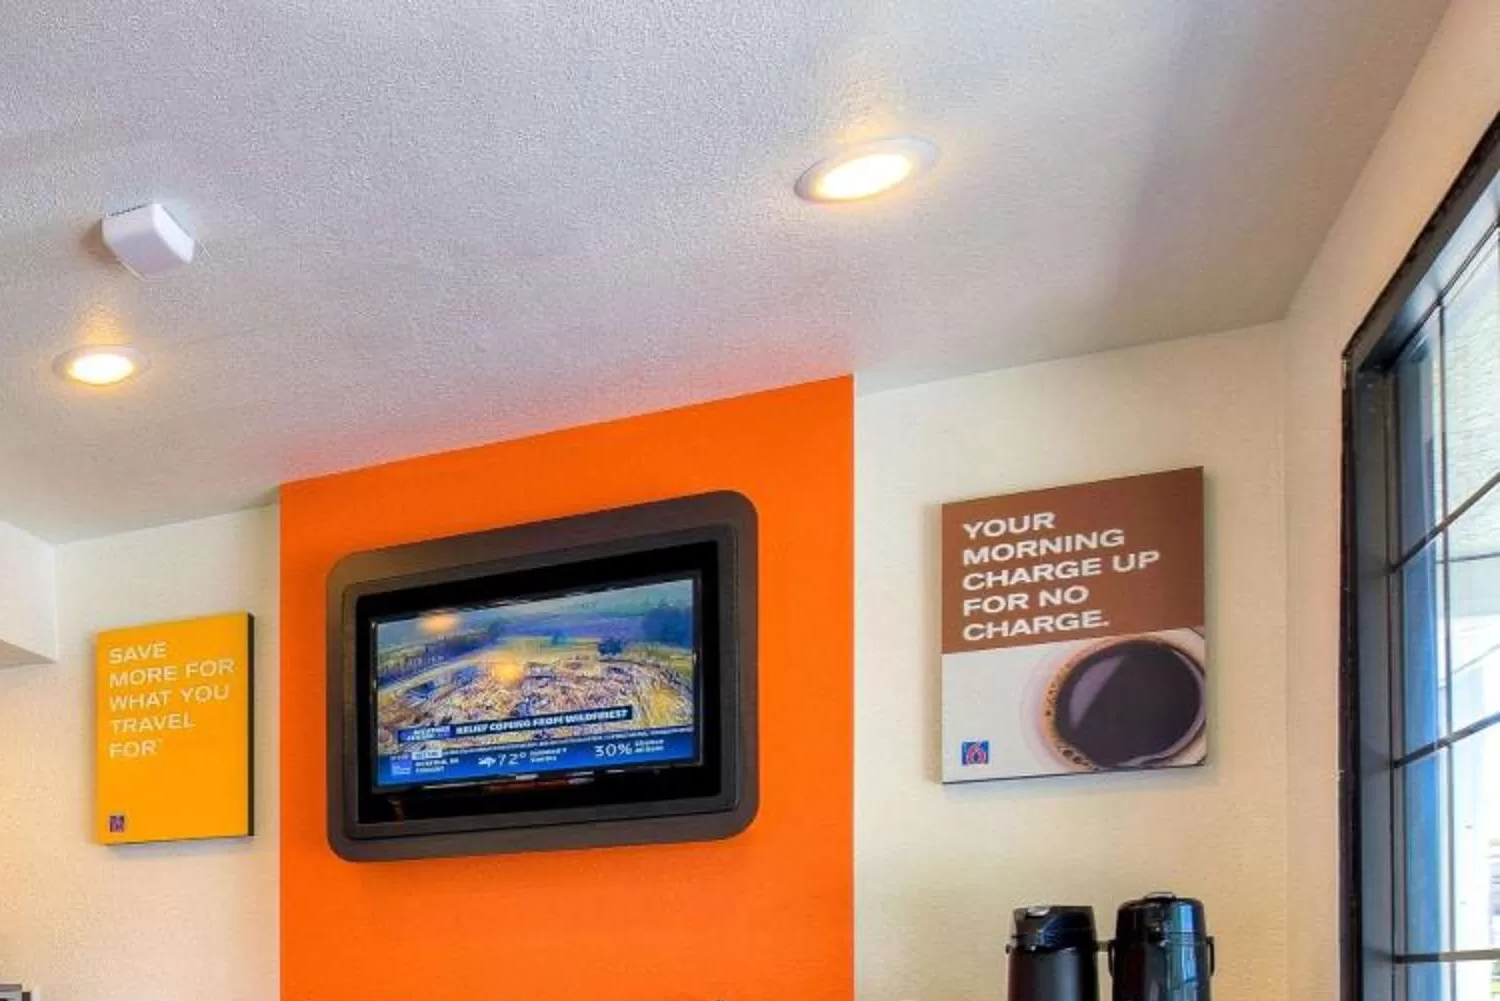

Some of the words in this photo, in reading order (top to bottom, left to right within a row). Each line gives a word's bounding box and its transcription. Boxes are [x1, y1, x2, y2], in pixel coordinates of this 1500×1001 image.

[963, 512, 1056, 539] YOUR
[963, 529, 1125, 566] MORNING
[963, 558, 1102, 591] CHARGE
[1112, 551, 1160, 573] UP
[963, 593, 1029, 616] FOR
[1039, 585, 1089, 606] NO
[963, 610, 1109, 641] CHARGE.
[109, 642, 167, 665] SAVE
[109, 665, 178, 688] MORE
[185, 659, 235, 679] FOR
[109, 690, 172, 712] WHAT
[181, 684, 230, 704] YOU
[109, 713, 196, 735] TRAVEL
[109, 739, 158, 760] FOR
[594, 743, 633, 758] 30%
